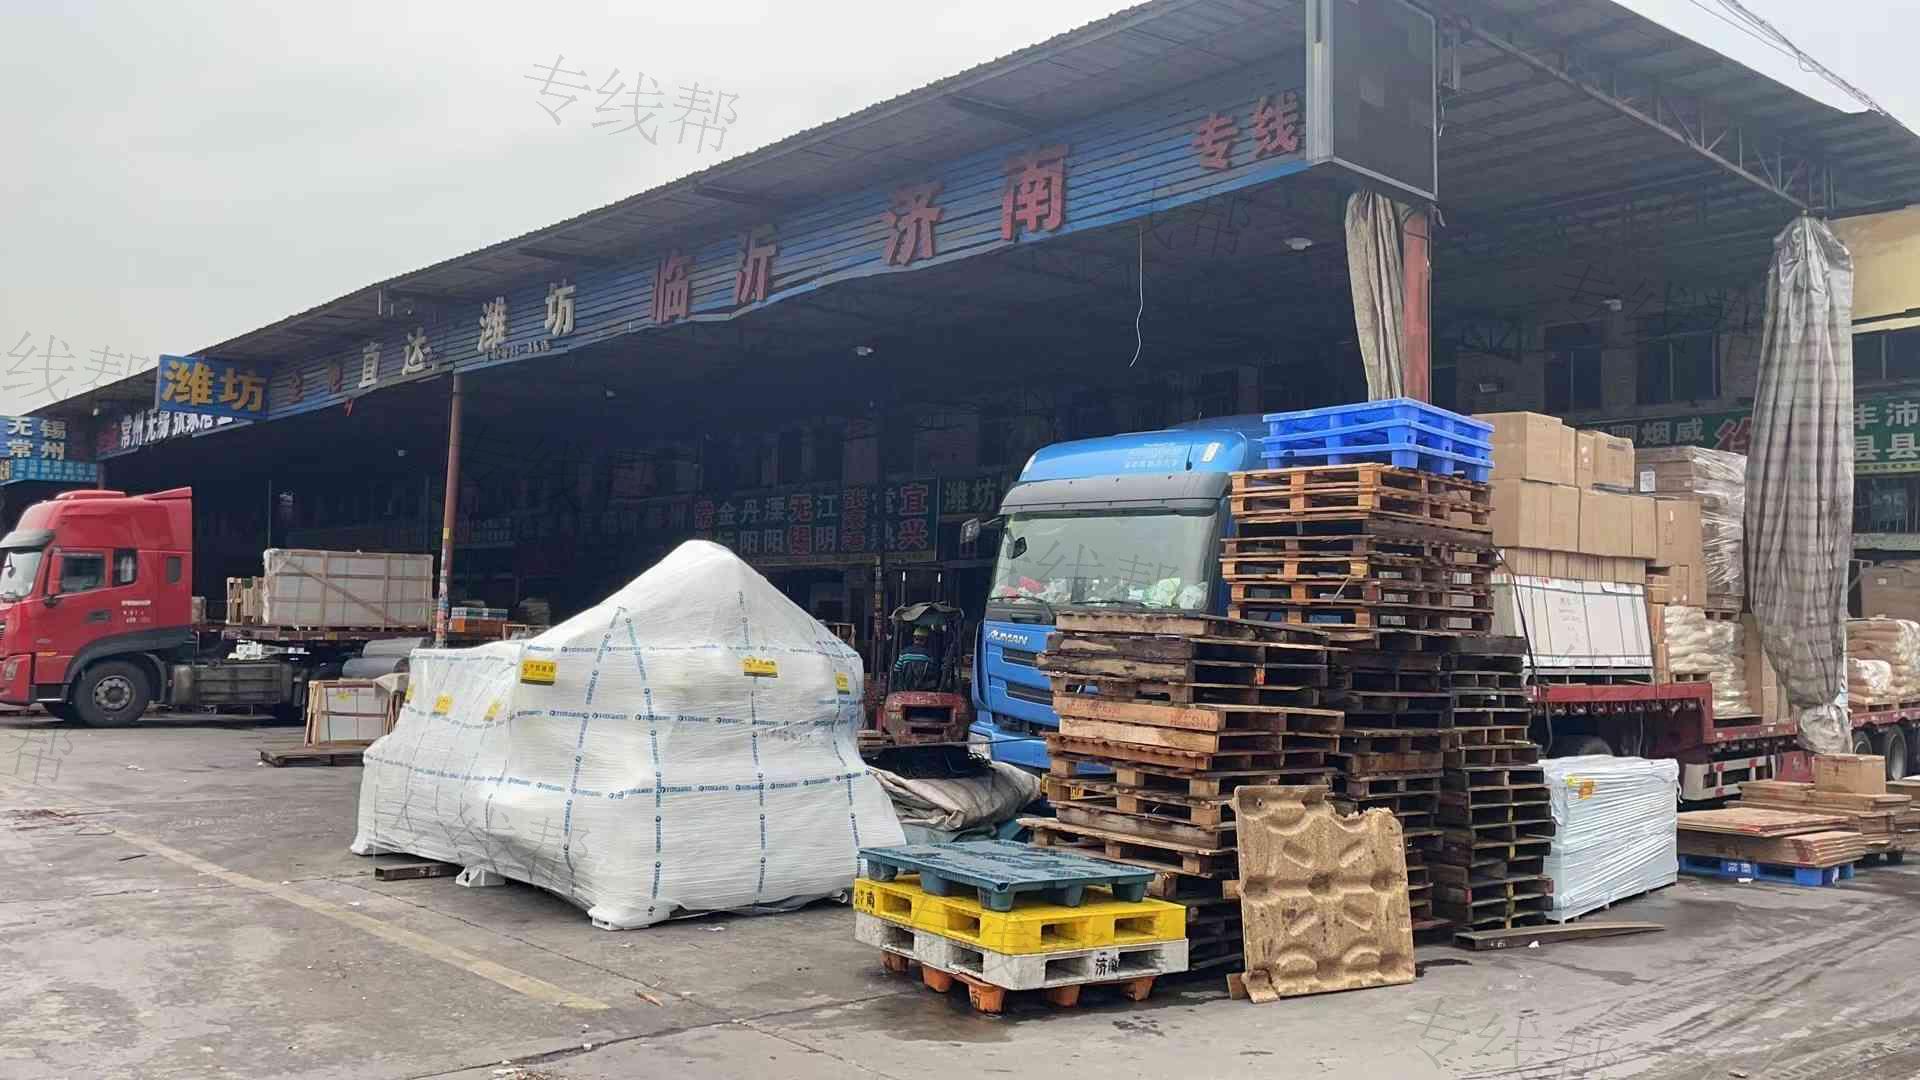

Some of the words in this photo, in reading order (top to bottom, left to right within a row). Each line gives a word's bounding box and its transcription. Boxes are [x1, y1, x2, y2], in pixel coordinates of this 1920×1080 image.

[358, 327, 436, 389] 直达
[477, 278, 576, 352] 潍坊
[650, 221, 780, 324] 临沂
[880, 143, 1070, 266] 济南
[1192, 94, 1300, 170] 专线
[161, 360, 269, 411] 潍坊
[7, 416, 66, 440] 无锡
[6, 439, 66, 461] 常州
